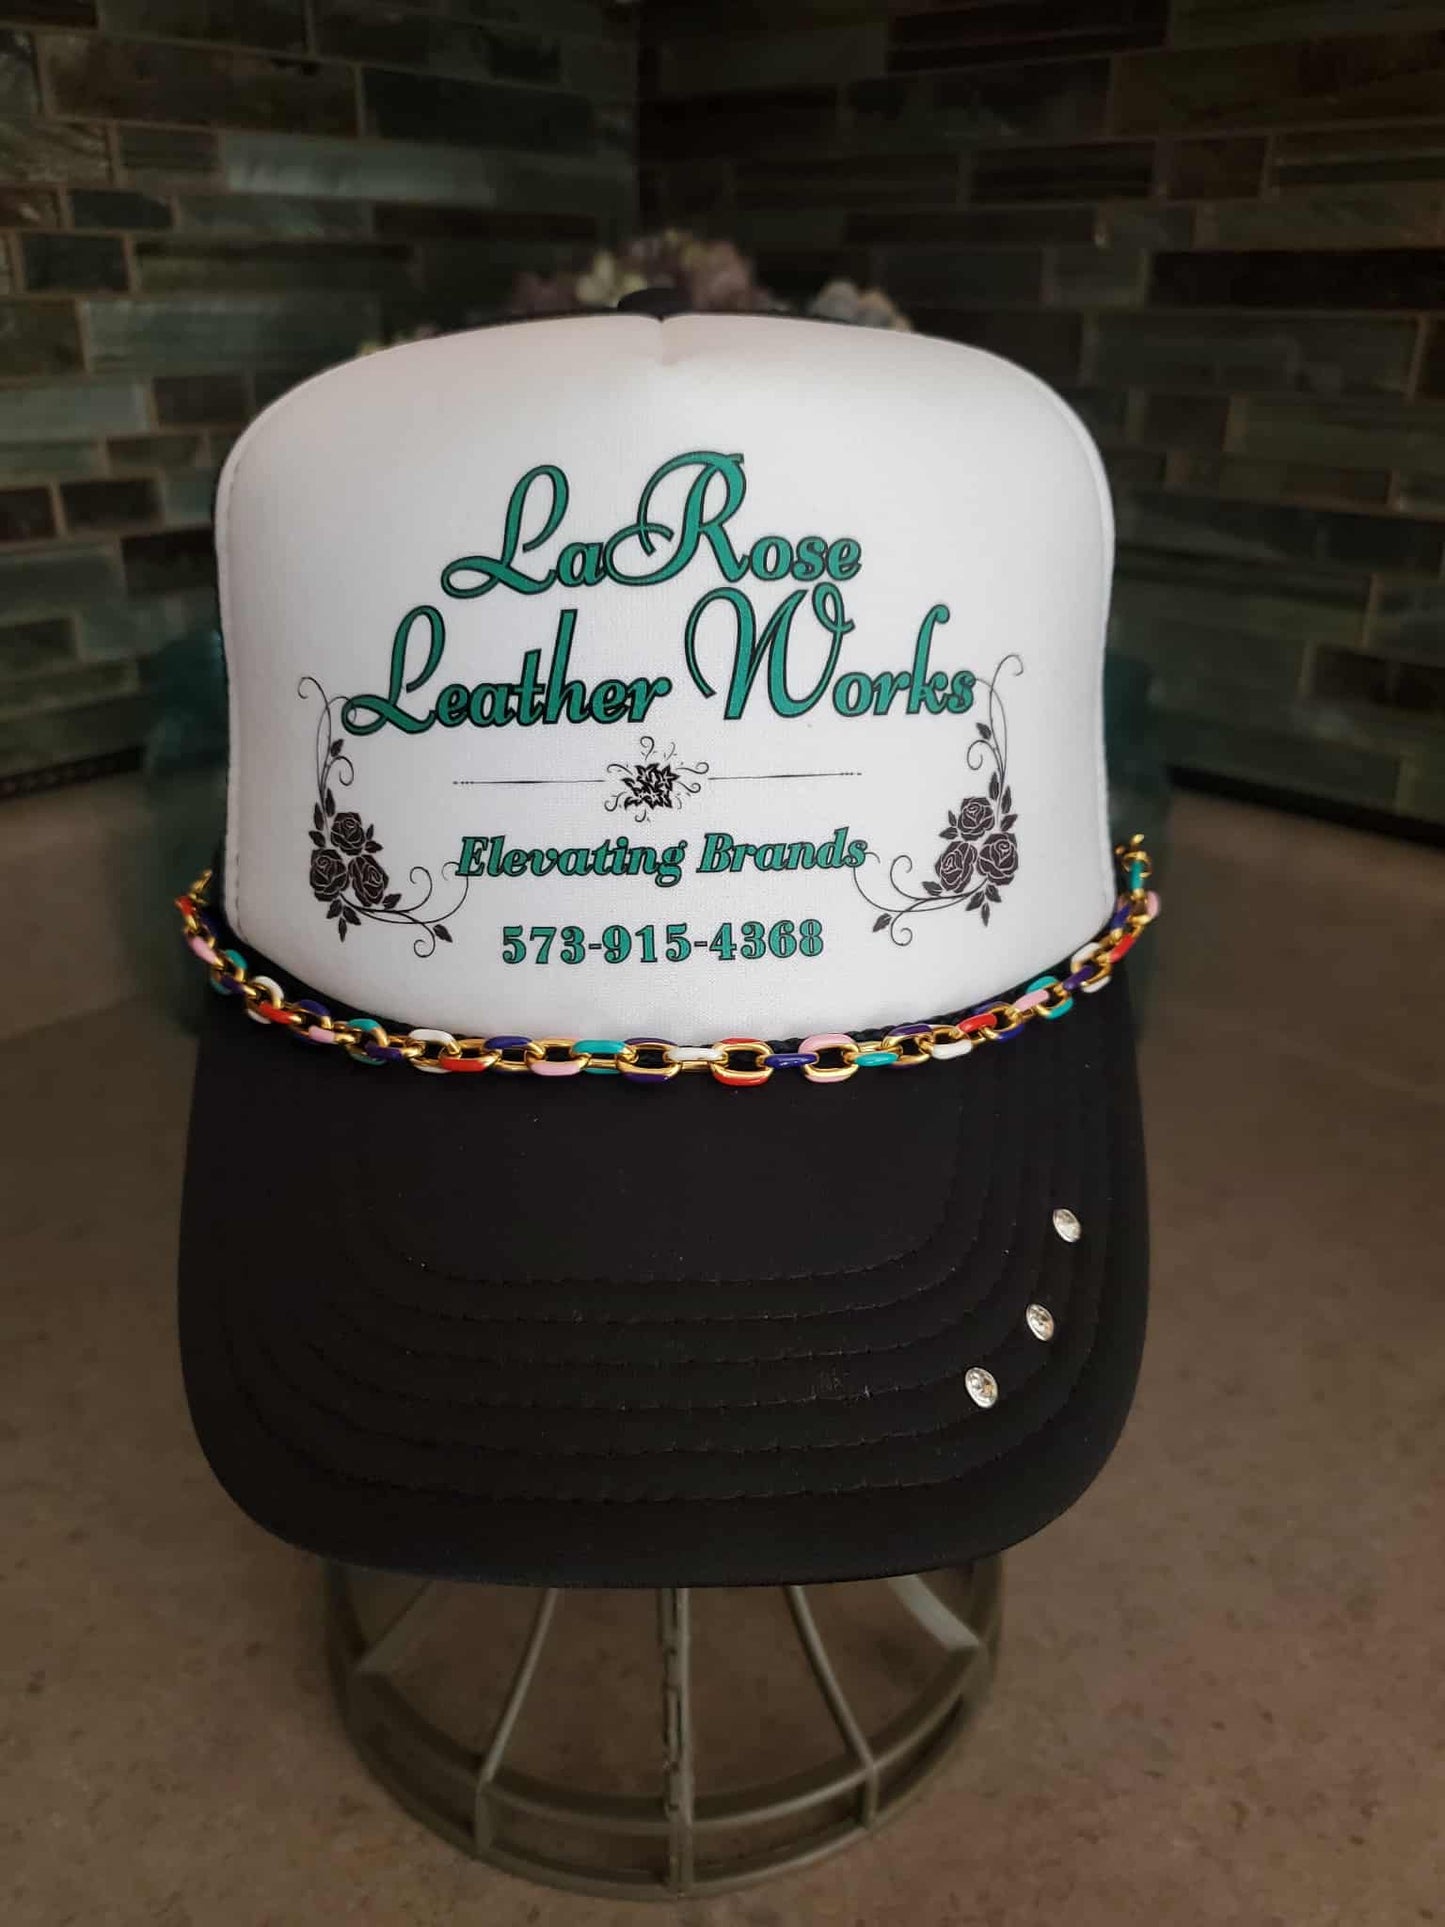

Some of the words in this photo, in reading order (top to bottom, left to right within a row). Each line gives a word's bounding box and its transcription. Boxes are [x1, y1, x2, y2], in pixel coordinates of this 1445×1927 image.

[440, 450, 862, 599] LaRose
[341, 605, 672, 736] Leather
[685, 582, 976, 720] Works
[455, 836, 687, 888] Elevating
[696, 827, 868, 876] Brands
[501, 920, 824, 964] 573-915-4368
